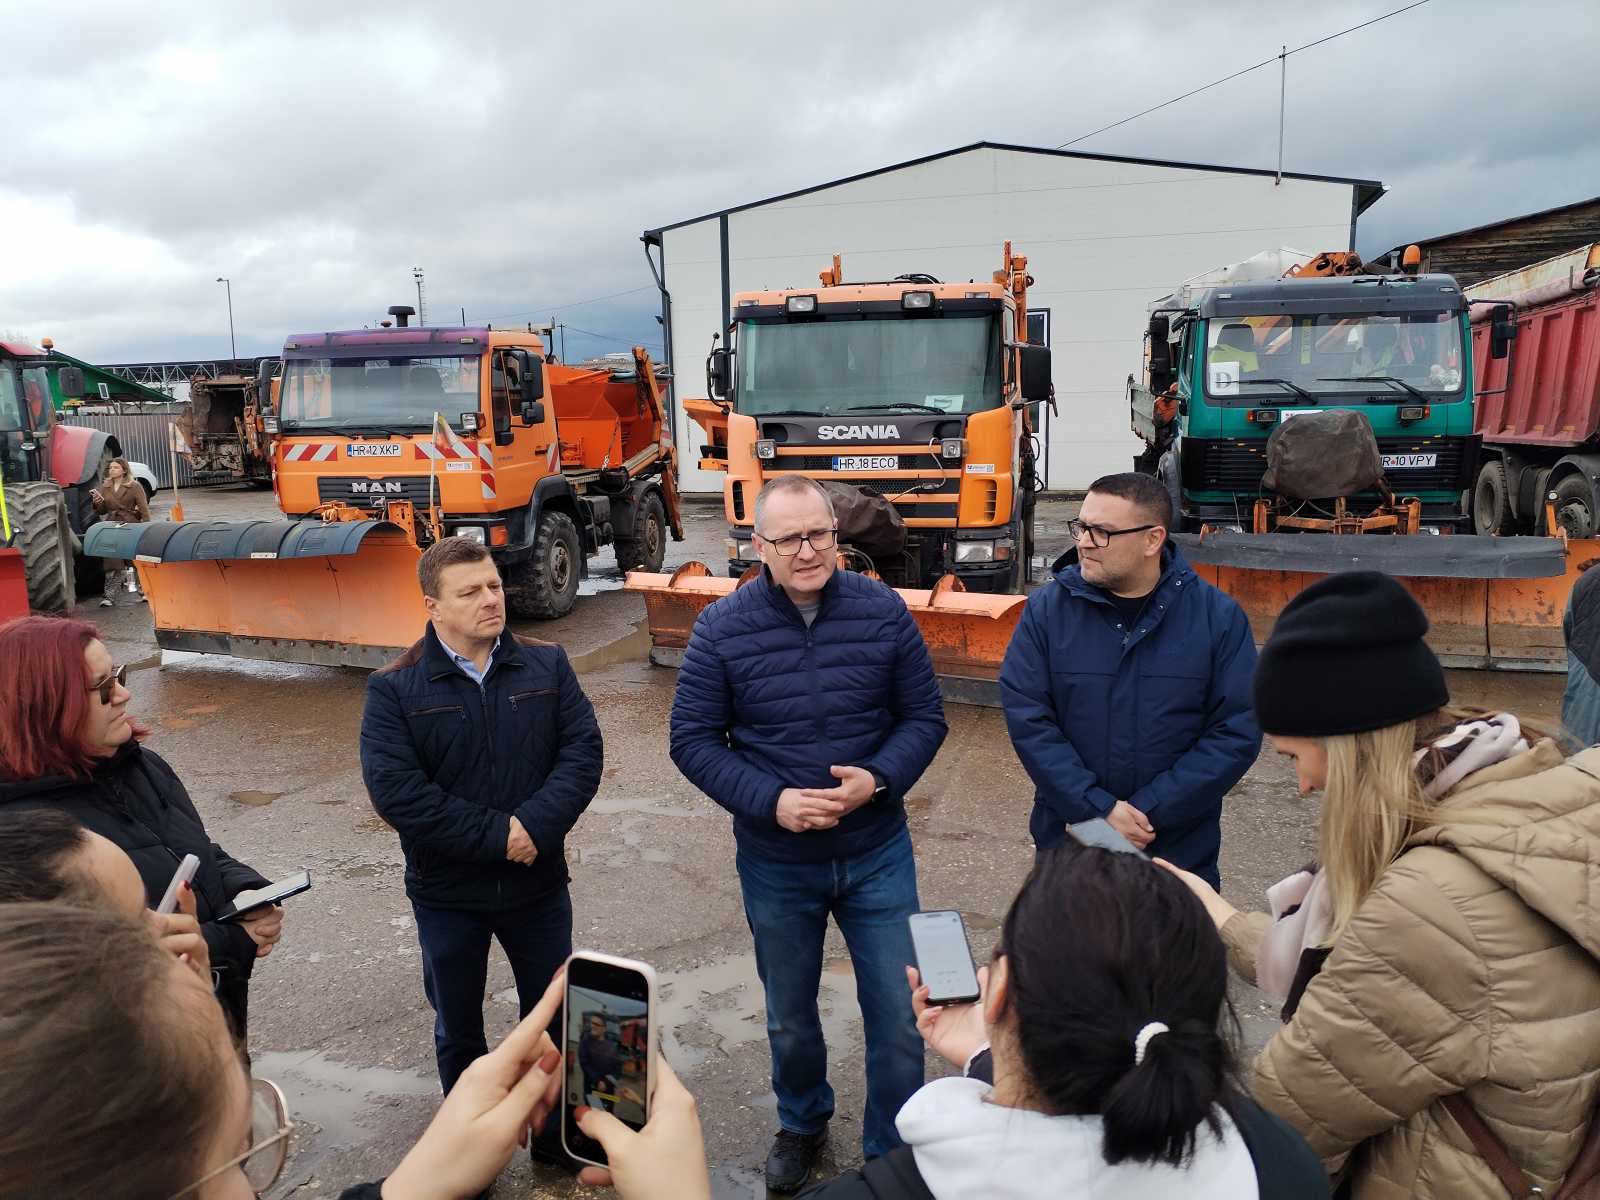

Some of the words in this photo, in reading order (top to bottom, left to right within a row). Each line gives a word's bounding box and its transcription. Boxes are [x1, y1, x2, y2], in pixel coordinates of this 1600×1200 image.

[1215, 371, 1232, 390] D
[817, 424, 901, 440] SCANIA
[352, 445, 366, 456] HR
[379, 444, 399, 456] XKP
[839, 458, 855, 470] HR
[858, 458, 869, 469] 18
[871, 457, 896, 469] ECO
[1395, 456, 1406, 466] 10
[1408, 455, 1433, 466] VPY
[352, 481, 402, 493] MAN
